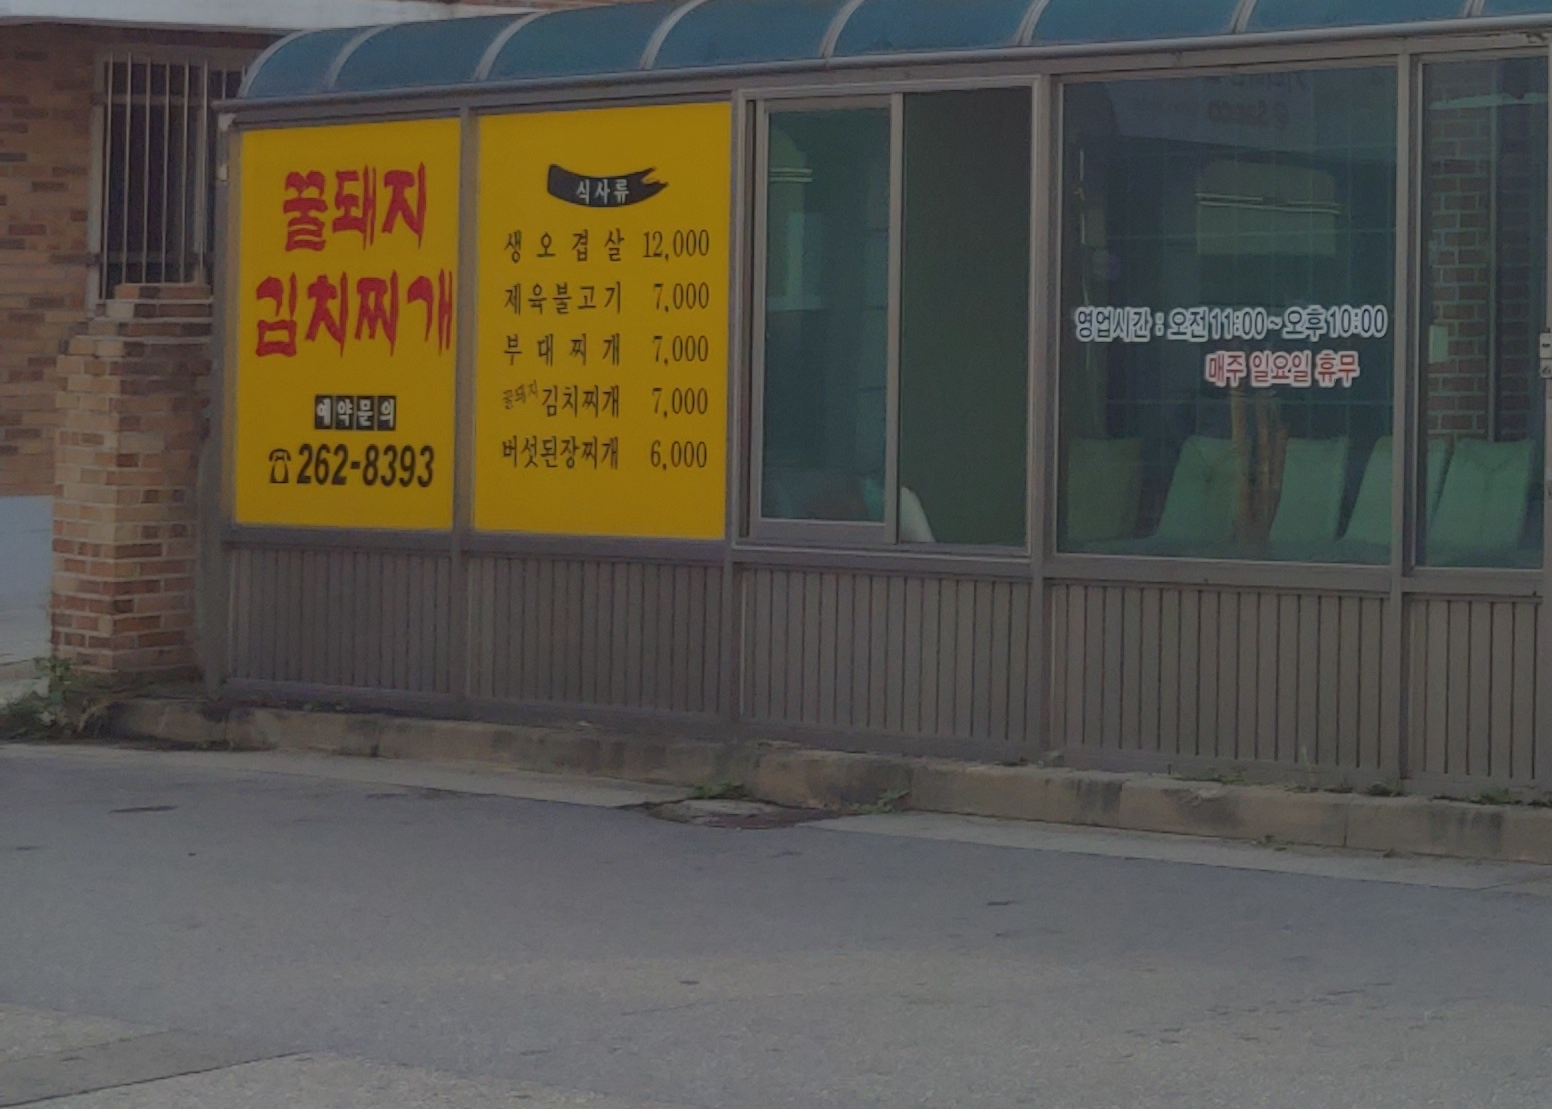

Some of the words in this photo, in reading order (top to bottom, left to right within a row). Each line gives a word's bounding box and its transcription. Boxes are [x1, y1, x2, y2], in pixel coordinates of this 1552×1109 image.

[283, 161, 427, 253] 꿀돼지
[575, 177, 631, 205] 식사류
[642, 229, 710, 261] 12,000
[255, 267, 453, 358] 김치찌개
[504, 282, 623, 315] 제육불고기
[653, 283, 710, 313] 7,000
[1075, 307, 1151, 341] 영업시간
[652, 334, 710, 365] 7,000
[1207, 351, 1247, 386] 매주
[1250, 351, 1311, 386] 일요일
[1315, 351, 1360, 386] 휴무
[316, 397, 395, 428] 예약문의
[542, 385, 620, 418] 김치찌개
[652, 387, 709, 419] 7,000
[296, 443, 436, 488] 262-8393
[502, 436, 620, 471] 버섯된장찌개
[650, 440, 708, 469] 6,000
